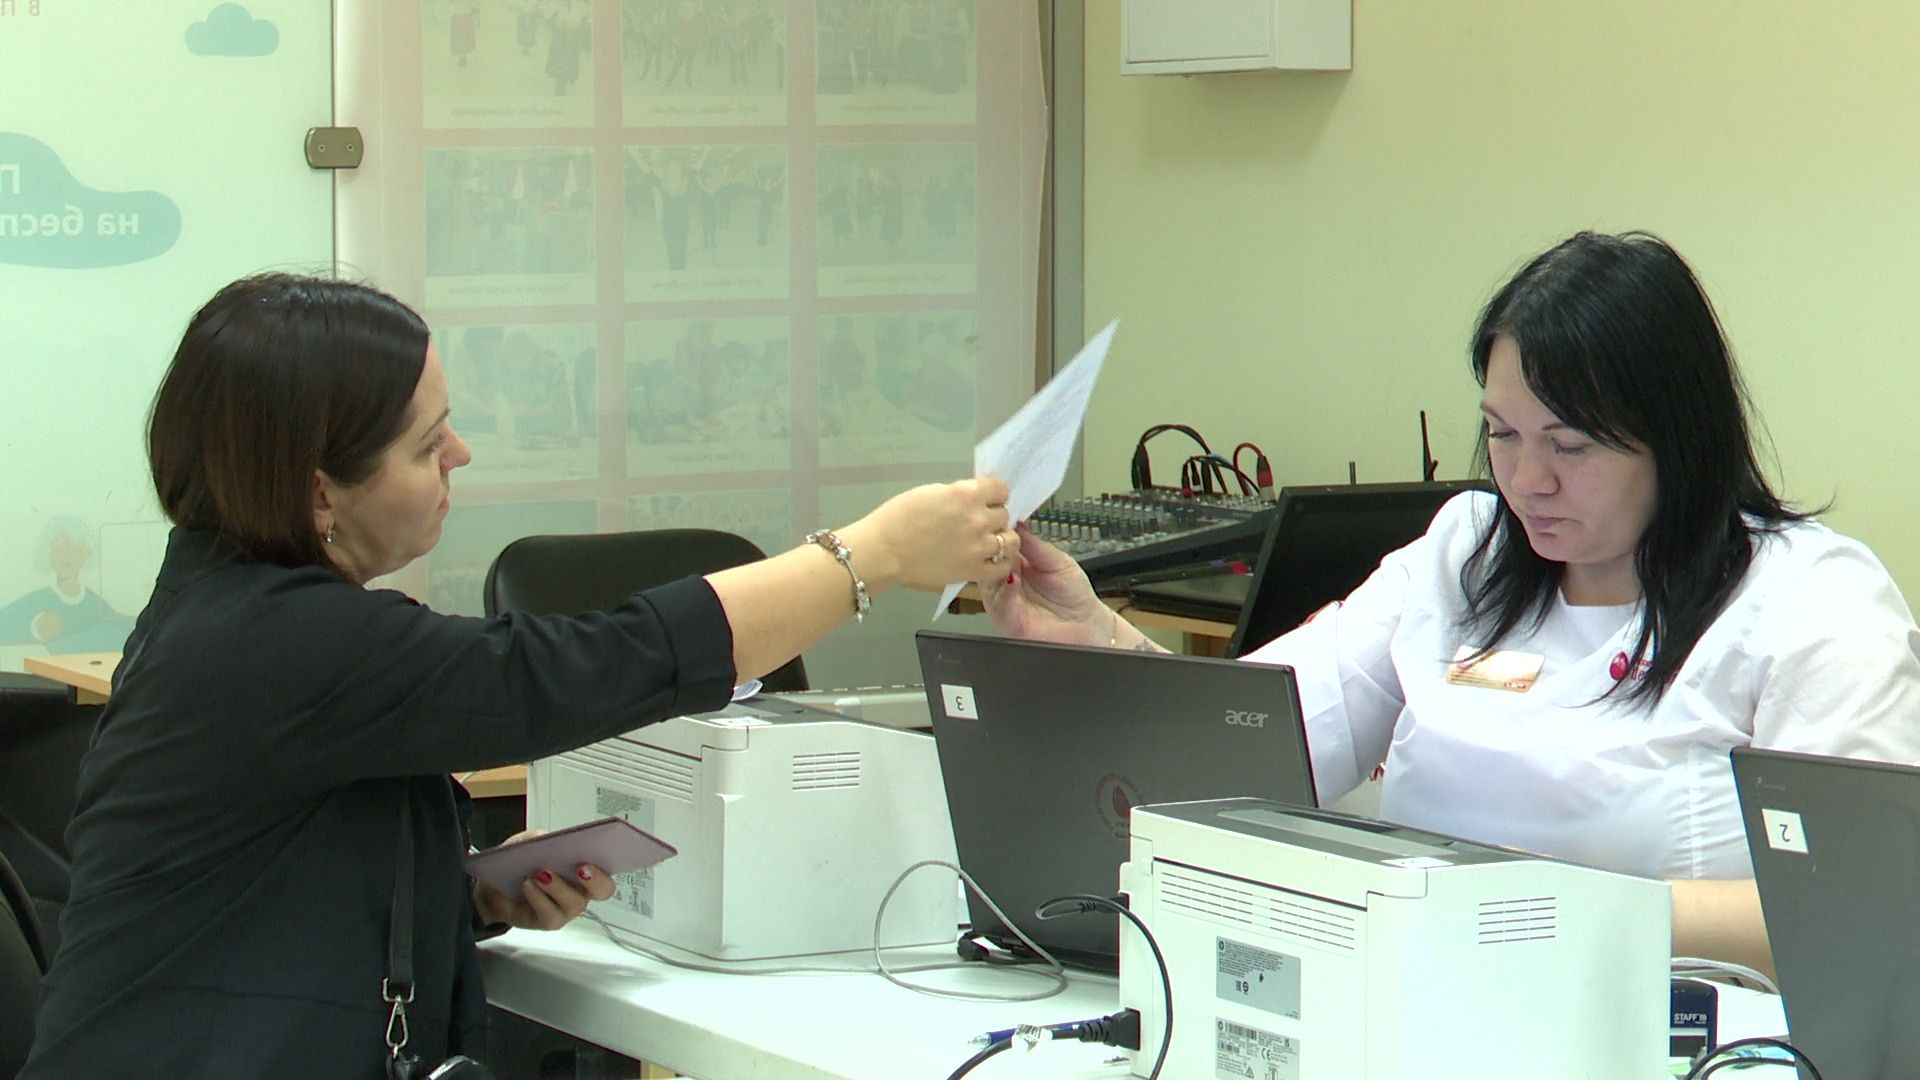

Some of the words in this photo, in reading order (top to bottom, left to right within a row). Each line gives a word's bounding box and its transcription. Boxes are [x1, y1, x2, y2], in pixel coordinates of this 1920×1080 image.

[955, 695, 965, 712] 3
[1224, 709, 1269, 728] acer
[1779, 823, 1791, 843] 2
